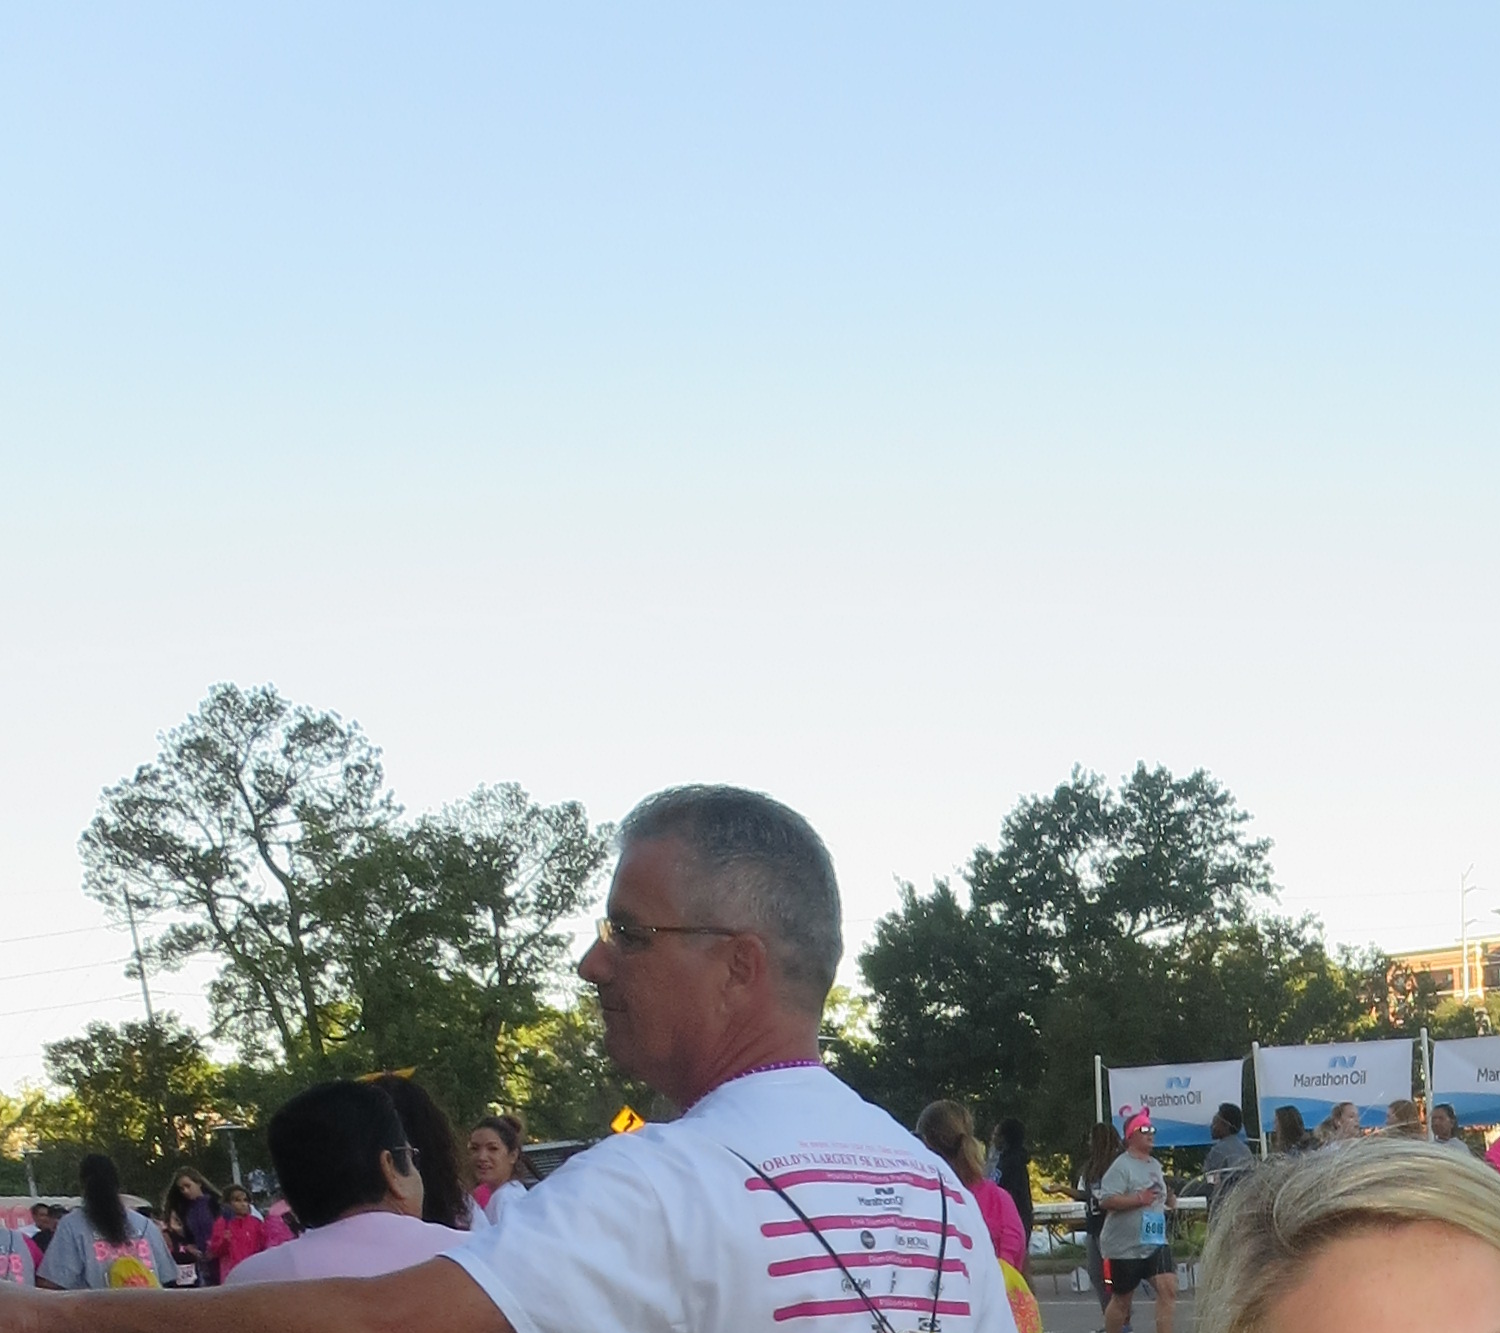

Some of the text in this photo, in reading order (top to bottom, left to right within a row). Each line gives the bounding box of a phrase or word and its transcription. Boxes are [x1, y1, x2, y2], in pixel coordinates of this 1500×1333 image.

[1293, 1069, 1367, 1088] Marathon Oil
[1140, 1090, 1202, 1108] Marathon Oil
[758, 1152, 811, 1172] ORLD'S
